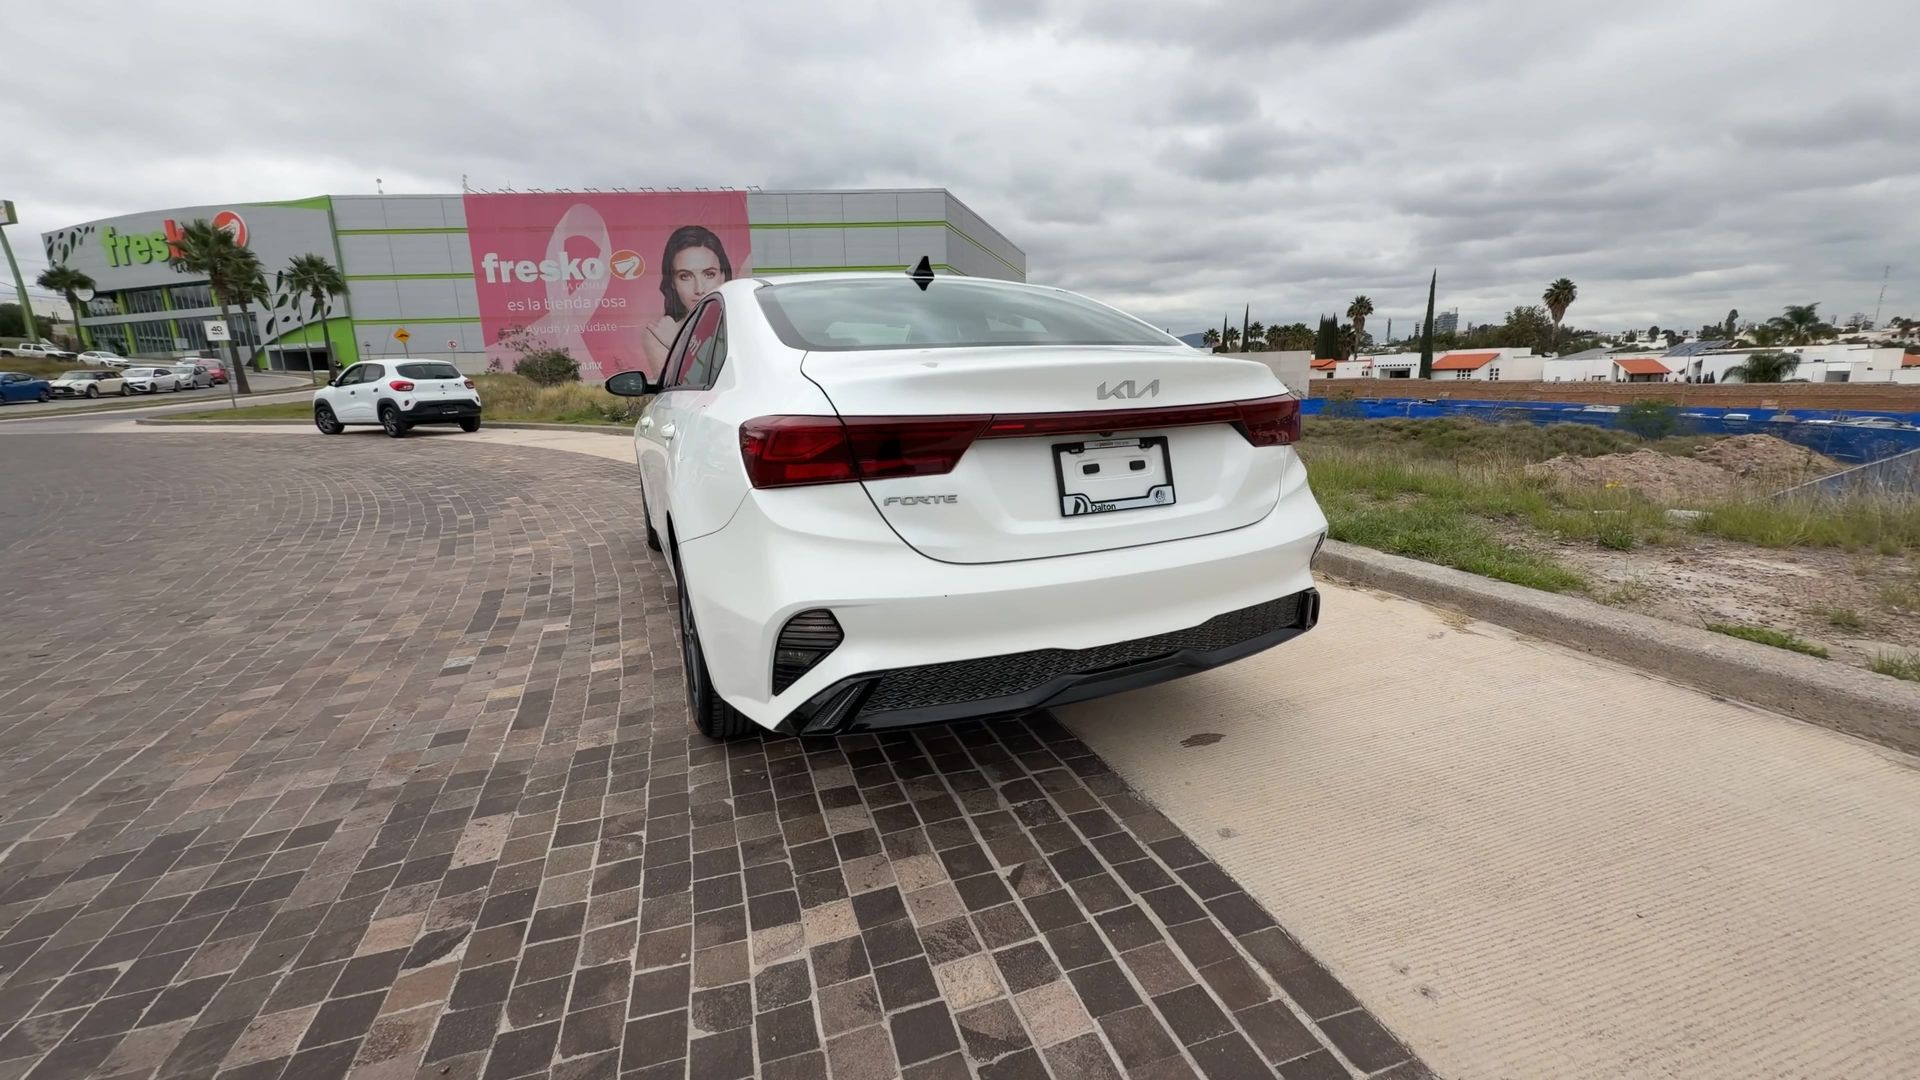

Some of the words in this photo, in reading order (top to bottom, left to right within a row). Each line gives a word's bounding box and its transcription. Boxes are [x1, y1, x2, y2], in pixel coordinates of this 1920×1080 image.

[102, 219, 187, 267] fresk
[482, 252, 605, 283] fresko
[507, 300, 525, 311] es
[528, 297, 541, 311] la
[544, 296, 592, 311] tienda
[594, 297, 627, 309] rosa
[883, 494, 958, 506] FORTE
[1090, 503, 1116, 512] Dalton
